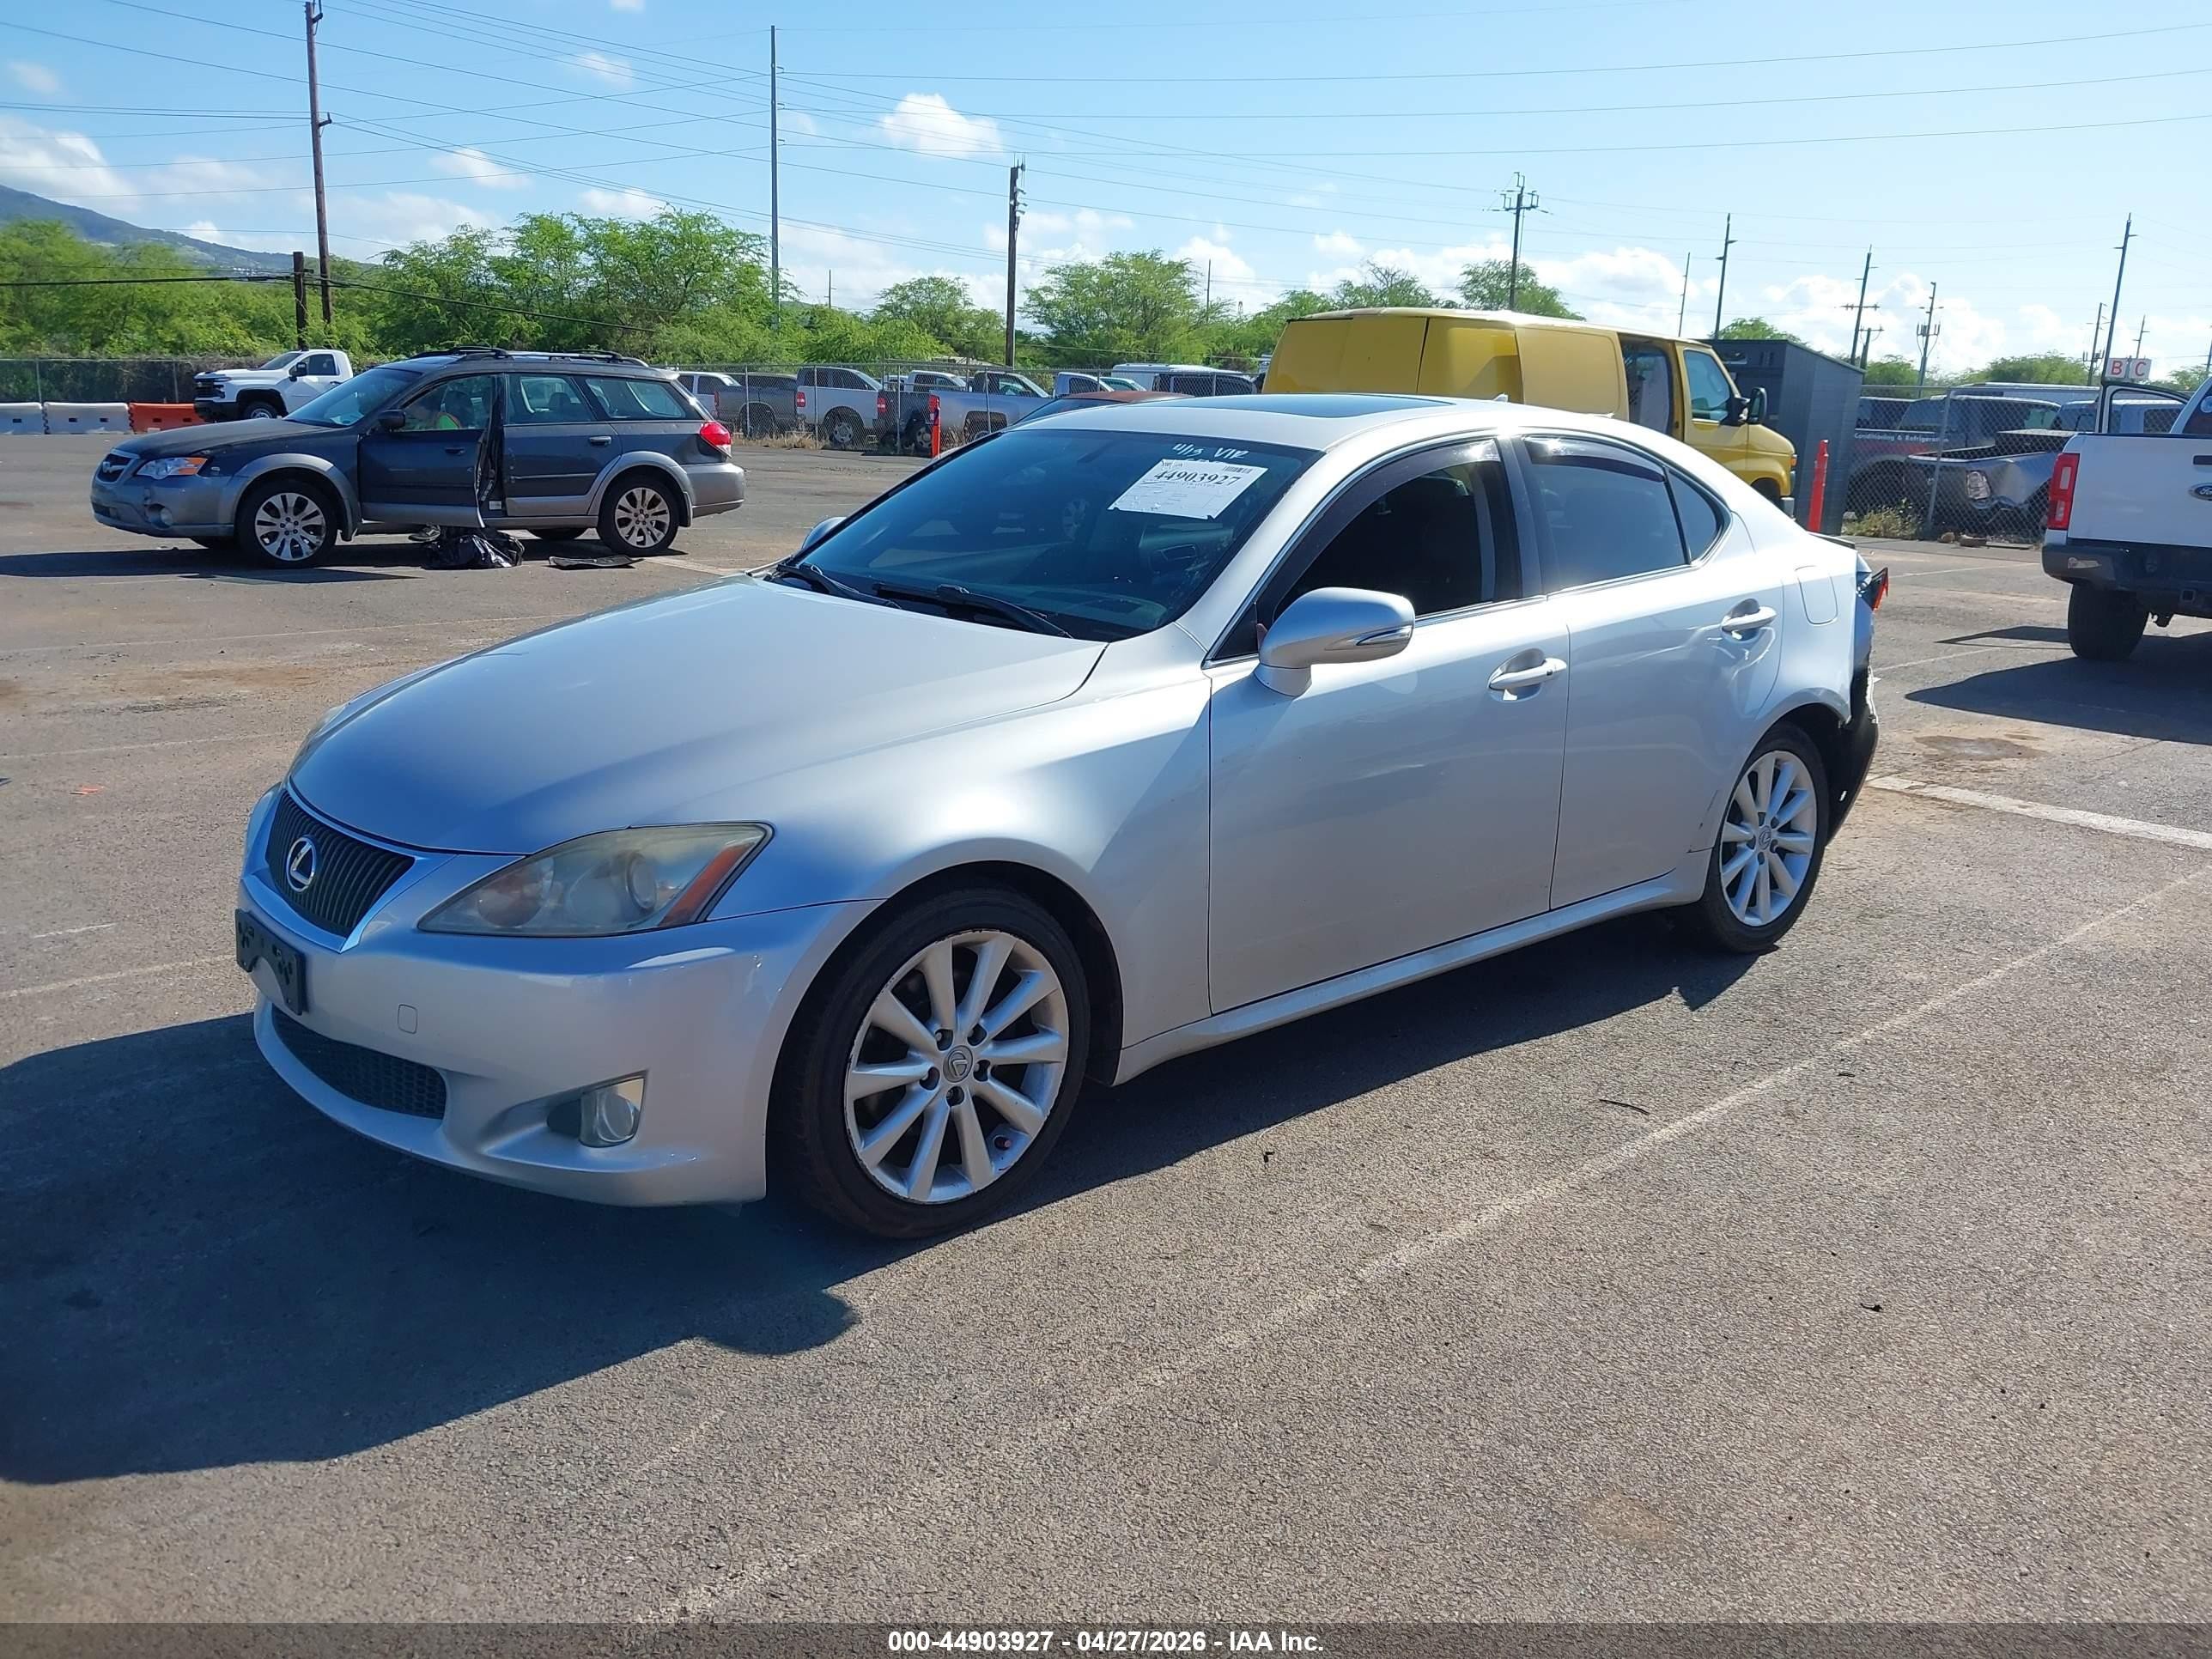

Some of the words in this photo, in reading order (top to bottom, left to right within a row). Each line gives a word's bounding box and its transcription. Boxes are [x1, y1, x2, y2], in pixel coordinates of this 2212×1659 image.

[2111, 360, 2123, 375] B
[2135, 361, 2147, 376] C
[1154, 470, 1243, 486] 44903927
